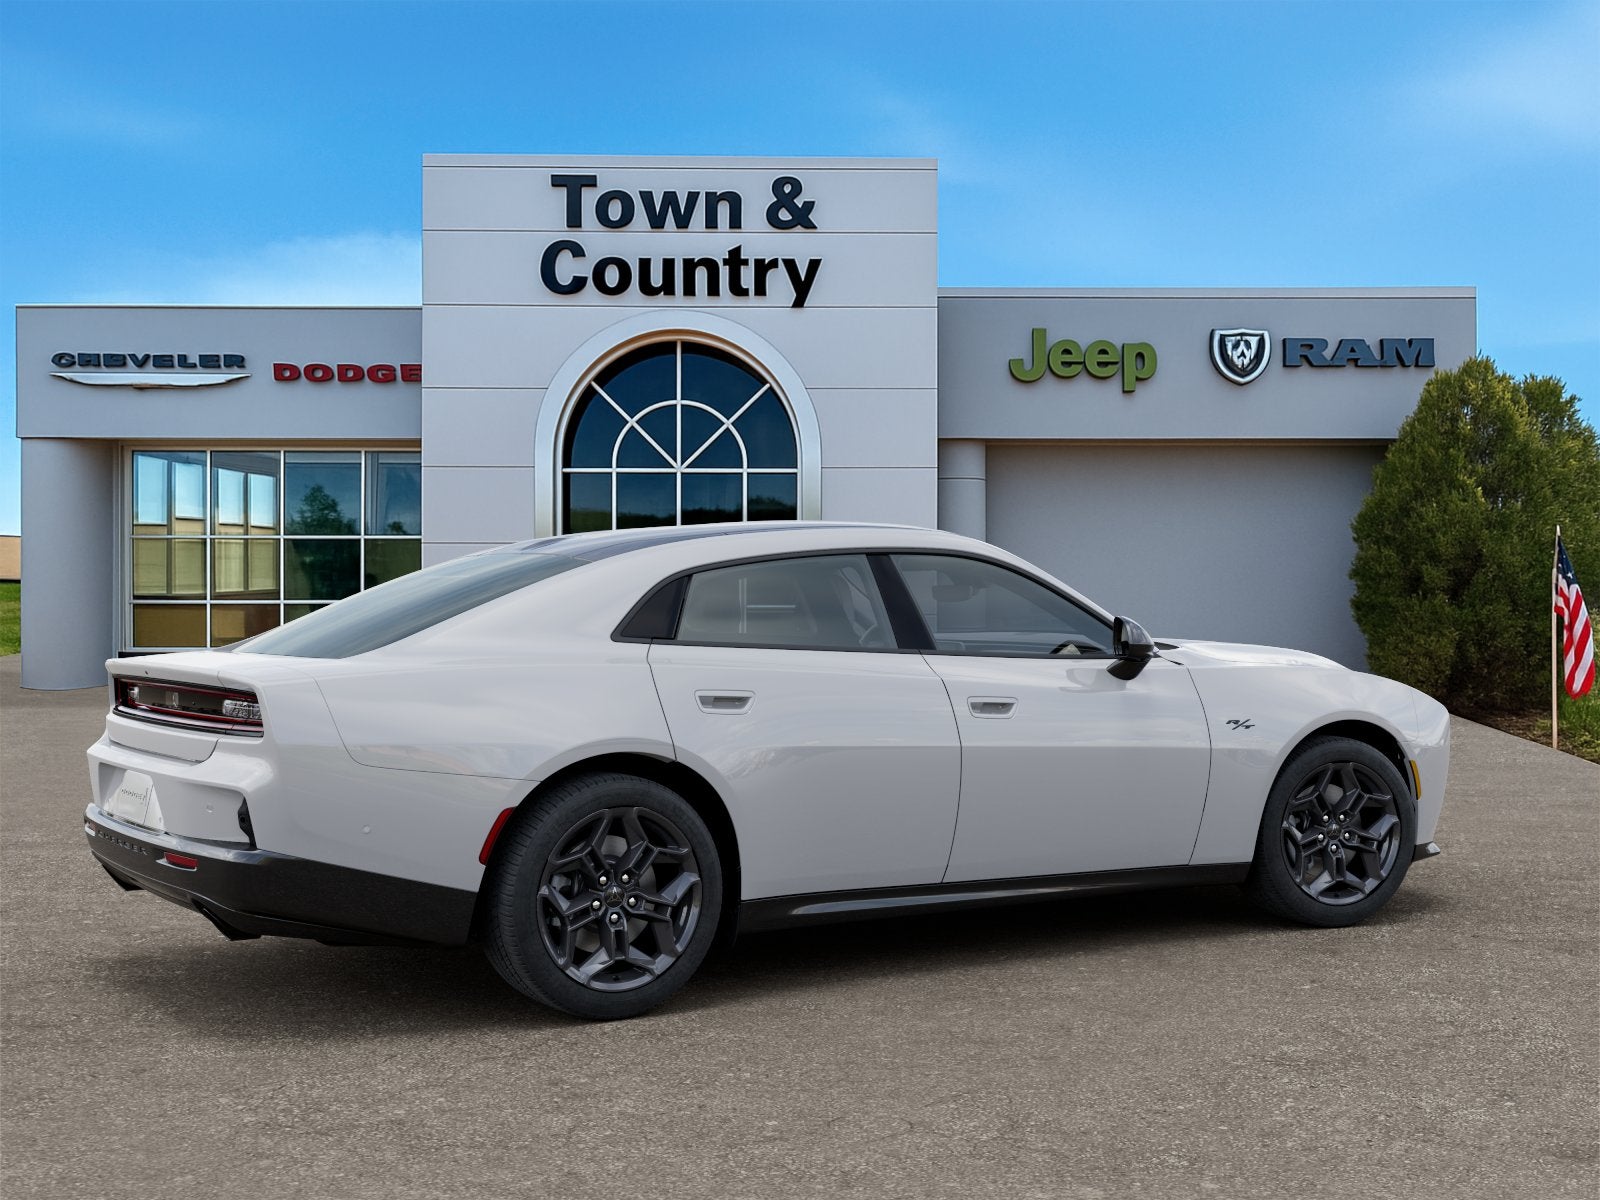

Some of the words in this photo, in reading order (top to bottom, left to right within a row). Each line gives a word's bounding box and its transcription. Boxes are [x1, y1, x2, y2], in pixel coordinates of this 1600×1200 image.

[551, 174, 742, 229] Town
[766, 176, 818, 230] &
[541, 239, 822, 308] Country
[273, 362, 422, 382] DODGE
[1009, 328, 1158, 393] Jeep
[1283, 338, 1435, 367] RAM
